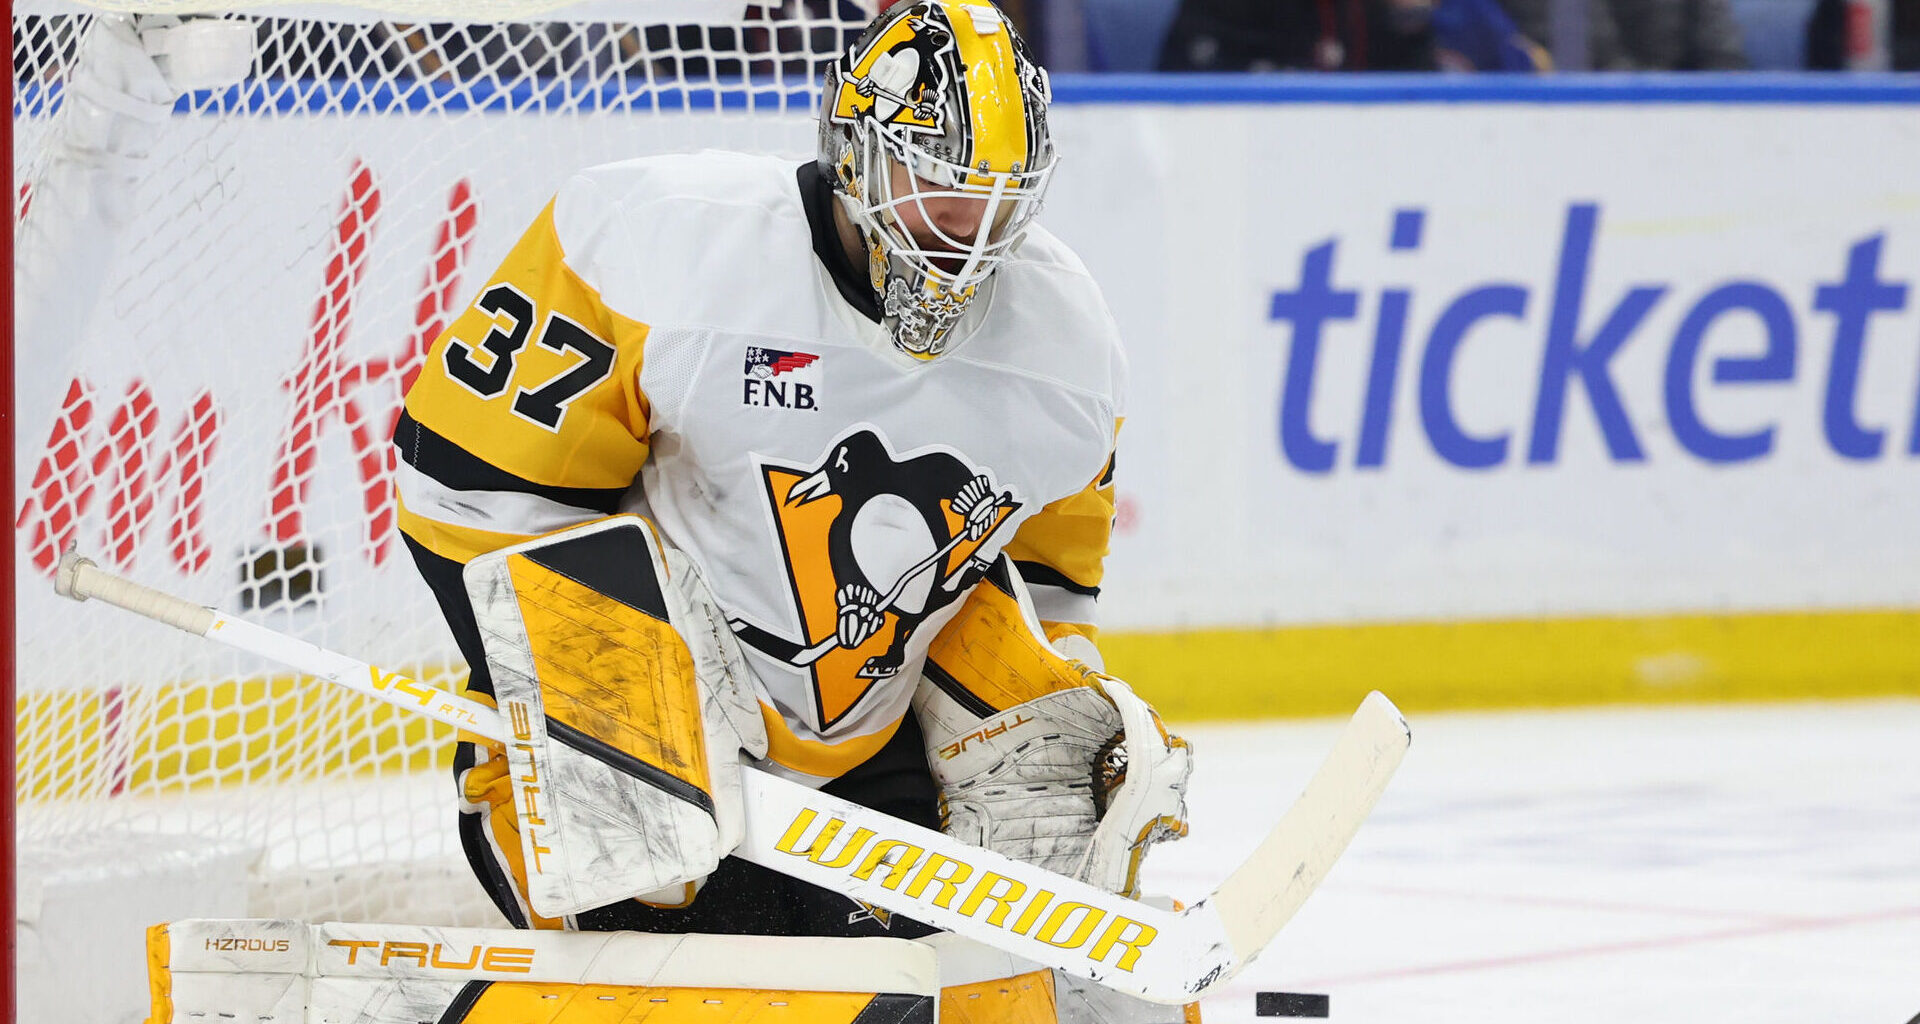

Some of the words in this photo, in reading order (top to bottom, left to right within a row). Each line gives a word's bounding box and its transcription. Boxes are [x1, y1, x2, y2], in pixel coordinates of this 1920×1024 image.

[441, 281, 618, 434] 37
[1268, 202, 1920, 475] ticket
[743, 378, 819, 412] F.N.B.
[369, 665, 437, 706] V4
[438, 703, 479, 725] RTL
[939, 714, 1035, 761] TRUE
[508, 701, 552, 876] TRUE
[773, 806, 1159, 973] WARRIOR
[204, 937, 290, 952] HZRDUS
[326, 939, 536, 973] TRUE
